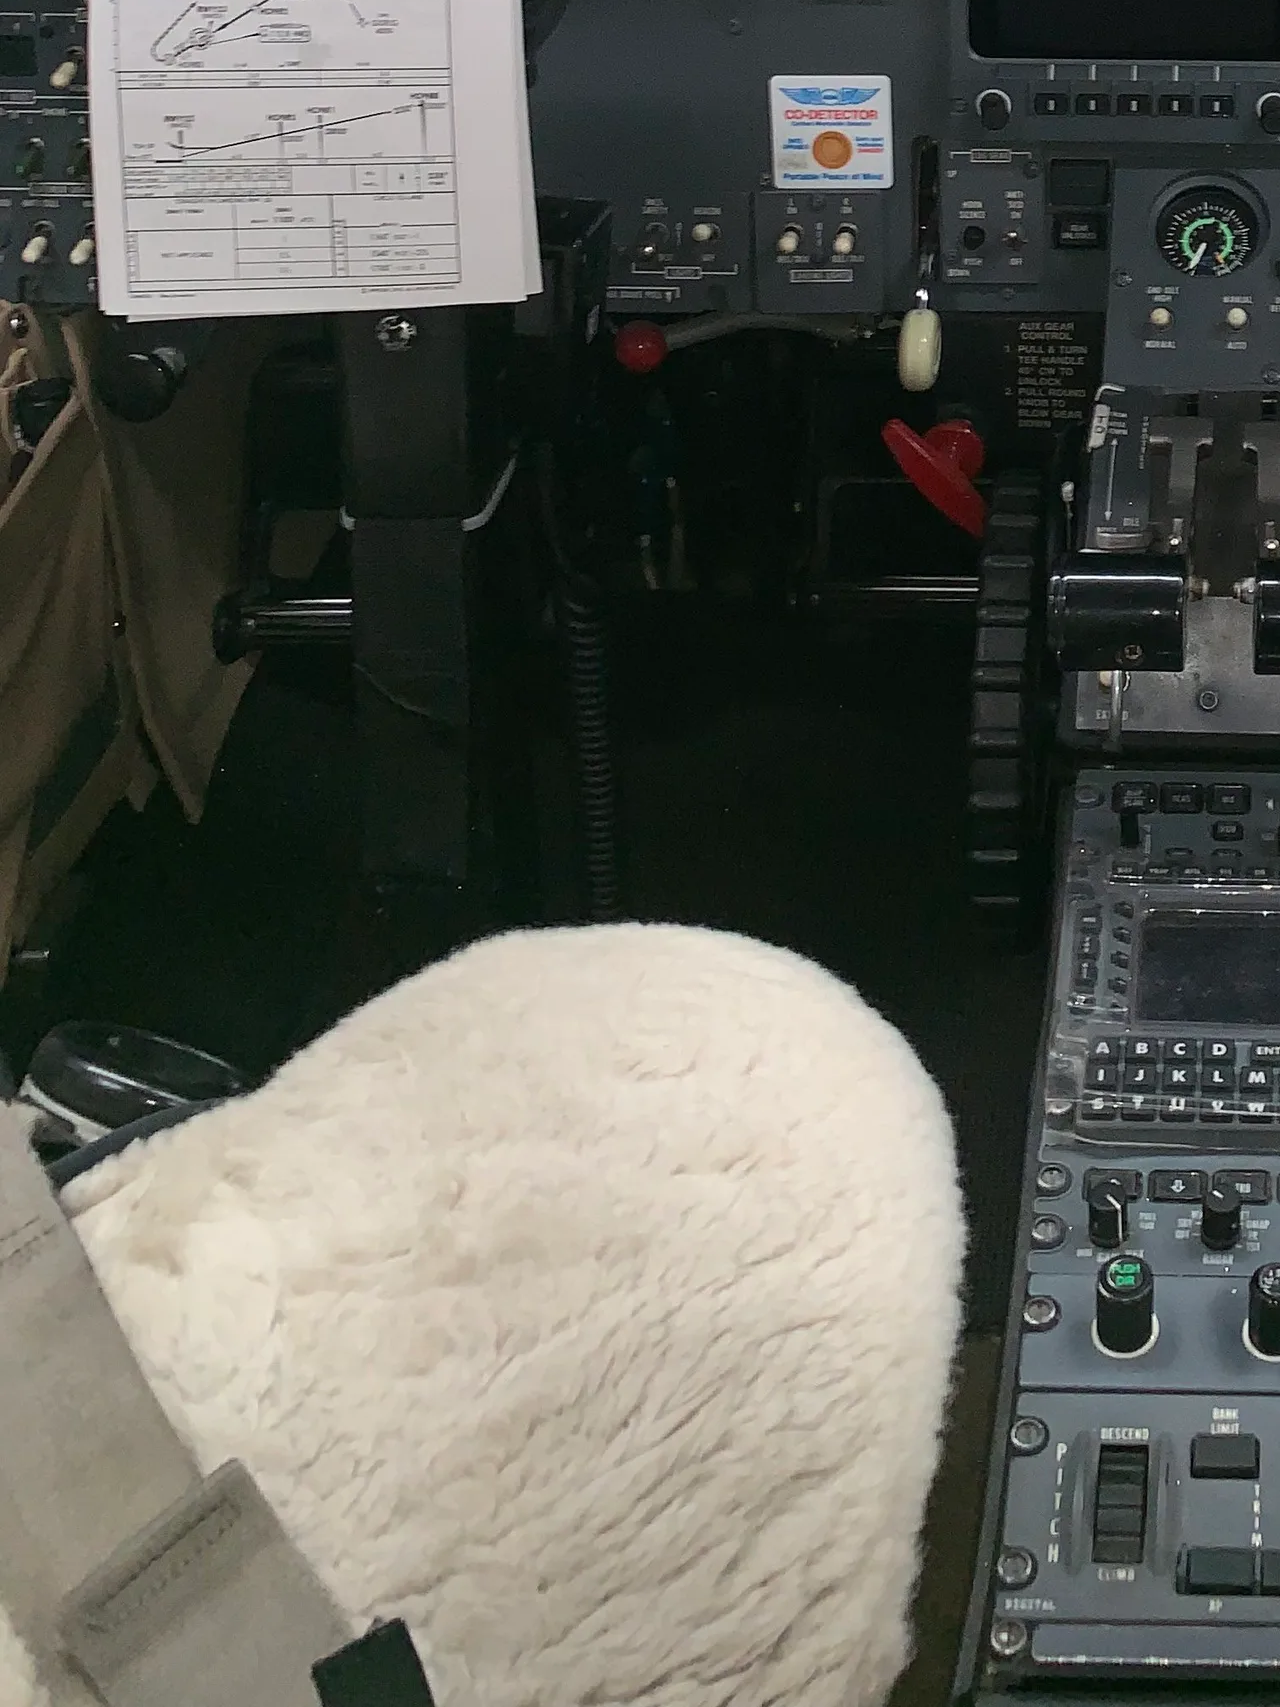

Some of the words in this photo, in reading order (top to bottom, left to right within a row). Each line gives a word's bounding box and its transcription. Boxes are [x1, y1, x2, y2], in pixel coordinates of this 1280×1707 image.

[785, 109, 878, 121] CO-DETECTOR
[1019, 322, 1042, 331] AUX
[1043, 323, 1075, 331] GEAR
[1021, 332, 1073, 341] CONTROL
[1018, 345, 1044, 354] PULL
[1060, 346, 1088, 354] TURN
[1018, 356, 1039, 364] TEE
[1041, 356, 1085, 365] HANDLE
[1059, 367, 1074, 376] TO
[1018, 387, 1045, 396] PULL
[1051, 399, 1066, 407] TO
[1051, 410, 1083, 419] GEAR
[1095, 1041, 1110, 1055] A
[1135, 1041, 1149, 1055] B
[1173, 1042, 1187, 1056] C
[1212, 1043, 1227, 1056] D
[1097, 1068, 1105, 1082] I
[1135, 1069, 1145, 1082] J
[1172, 1069, 1187, 1083] K
[1213, 1070, 1224, 1083] L
[1248, 1071, 1266, 1084] M
[1211, 1407, 1239, 1420] BANK
[1100, 1427, 1150, 1440] DESCEND
[1210, 1422, 1240, 1435] LIMIT
[1251, 1483, 1263, 1548] TRIM
[1004, 1597, 1056, 1611] DIGITAL
